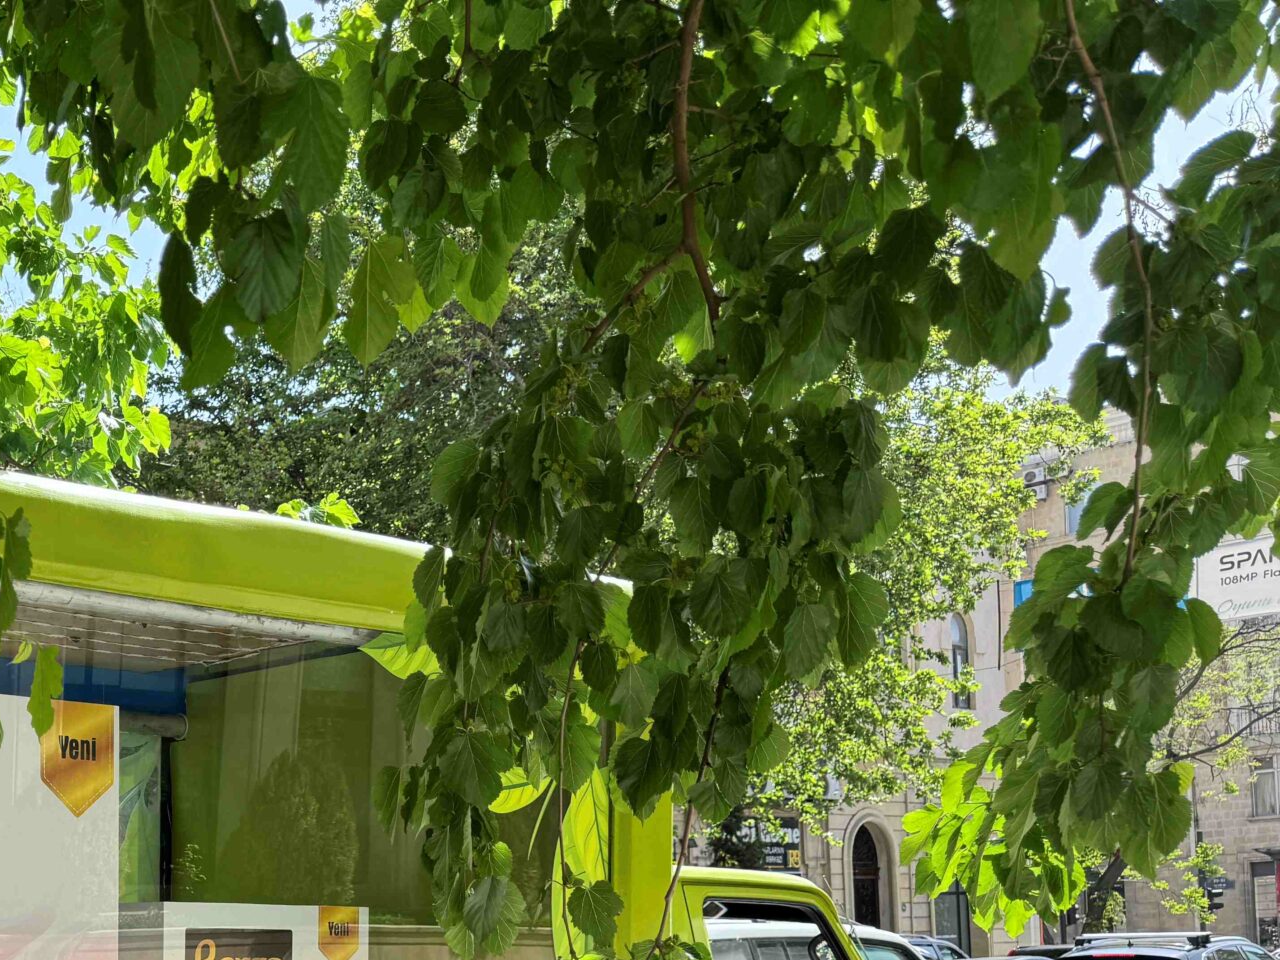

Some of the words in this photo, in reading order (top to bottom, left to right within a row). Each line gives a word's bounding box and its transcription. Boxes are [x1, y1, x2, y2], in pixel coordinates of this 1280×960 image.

[1220, 571, 1259, 587] 108MP
[58, 735, 97, 762] Yeni
[327, 921, 350, 937] Yeni
